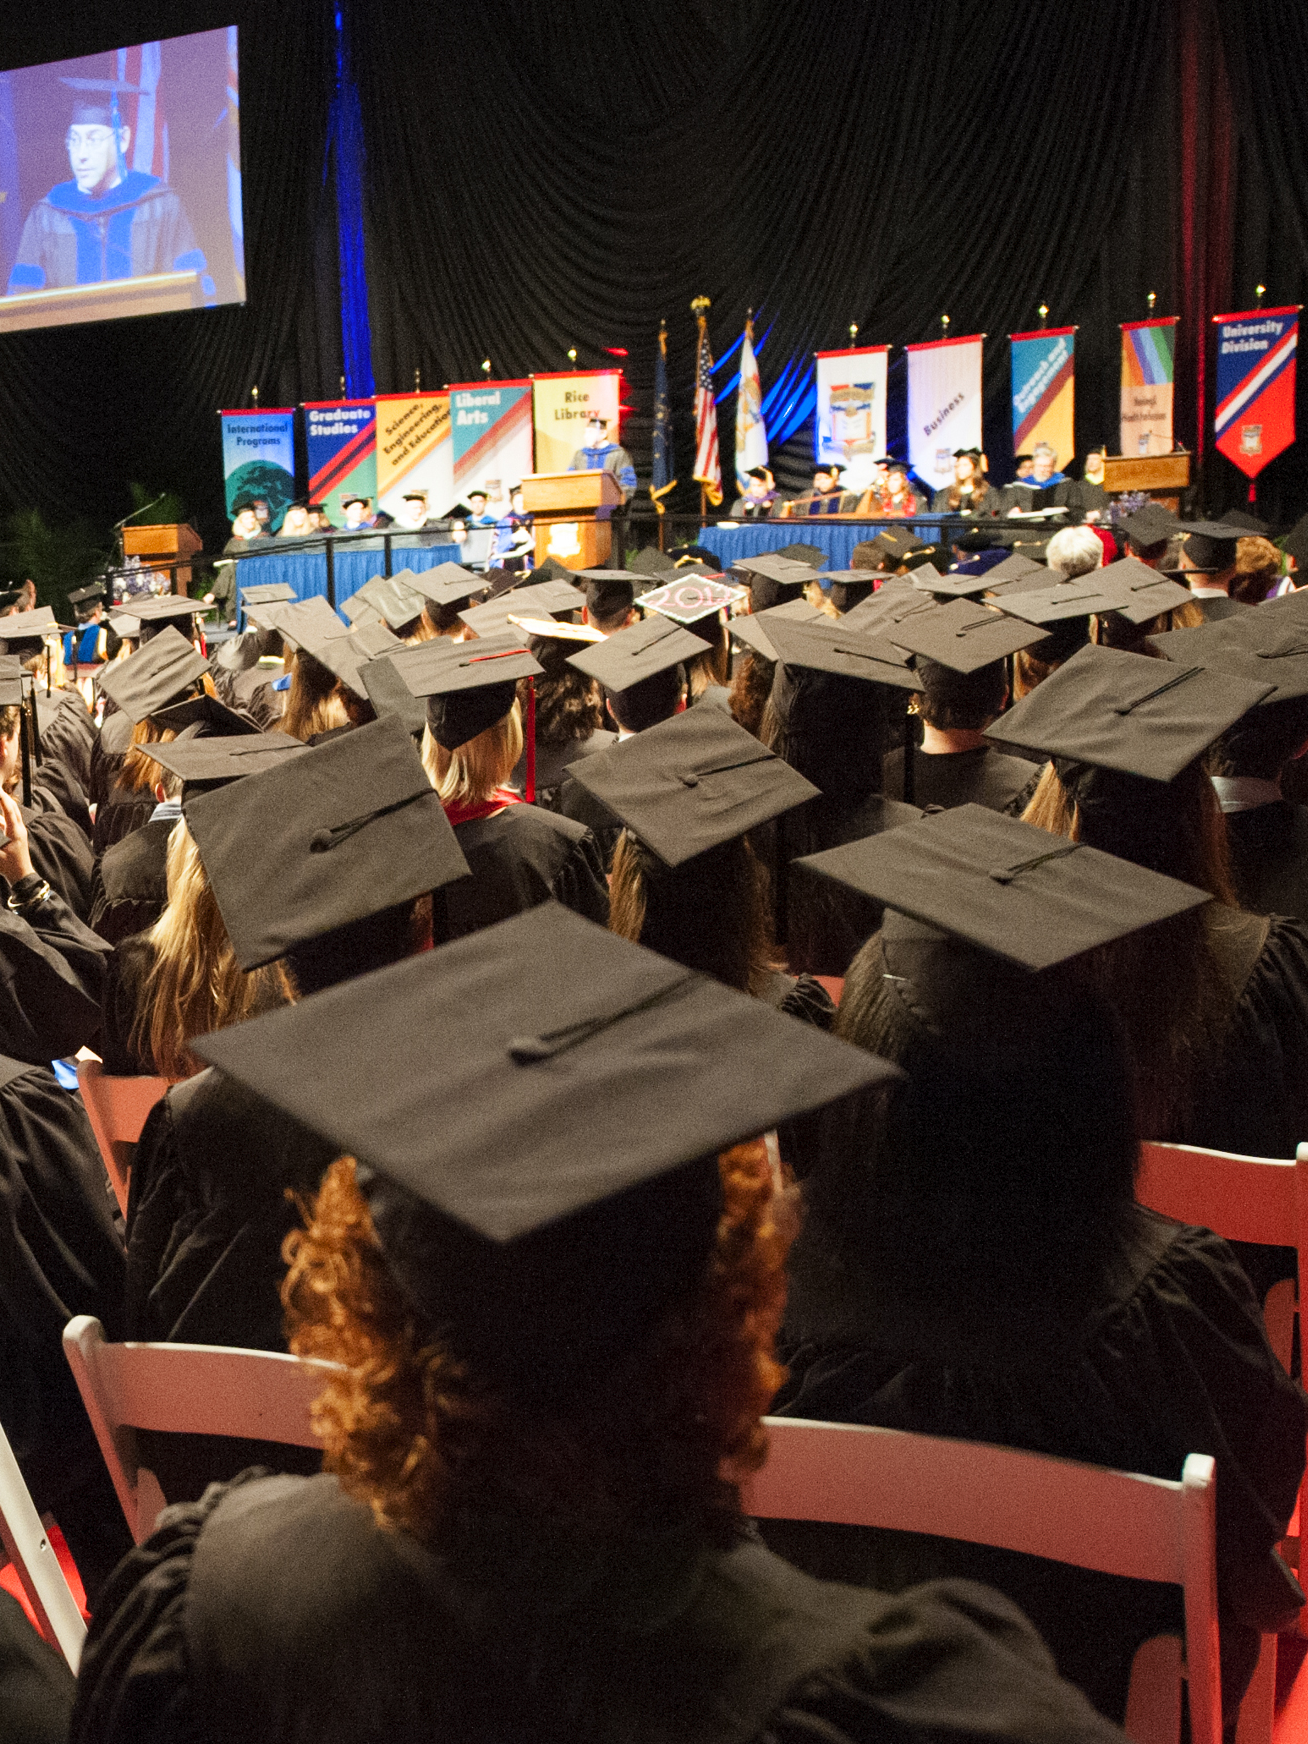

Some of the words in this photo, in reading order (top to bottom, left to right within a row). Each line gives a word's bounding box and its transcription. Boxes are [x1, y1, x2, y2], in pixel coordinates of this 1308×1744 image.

[1222, 320, 1284, 339] University
[1221, 337, 1269, 354] Division
[455, 391, 501, 408] Liberal
[564, 390, 590, 403] Rice
[309, 408, 371, 422] Graduate
[385, 403, 424, 436] Science,
[456, 410, 488, 426] Arts
[554, 408, 600, 421] Library
[923, 392, 965, 436] Business
[227, 422, 288, 435] International
[310, 422, 358, 437] Studies
[383, 403, 443, 455] Engineering,
[236, 436, 281, 449] Programs
[391, 449, 410, 466] and
[647, 585, 731, 609] 2012
